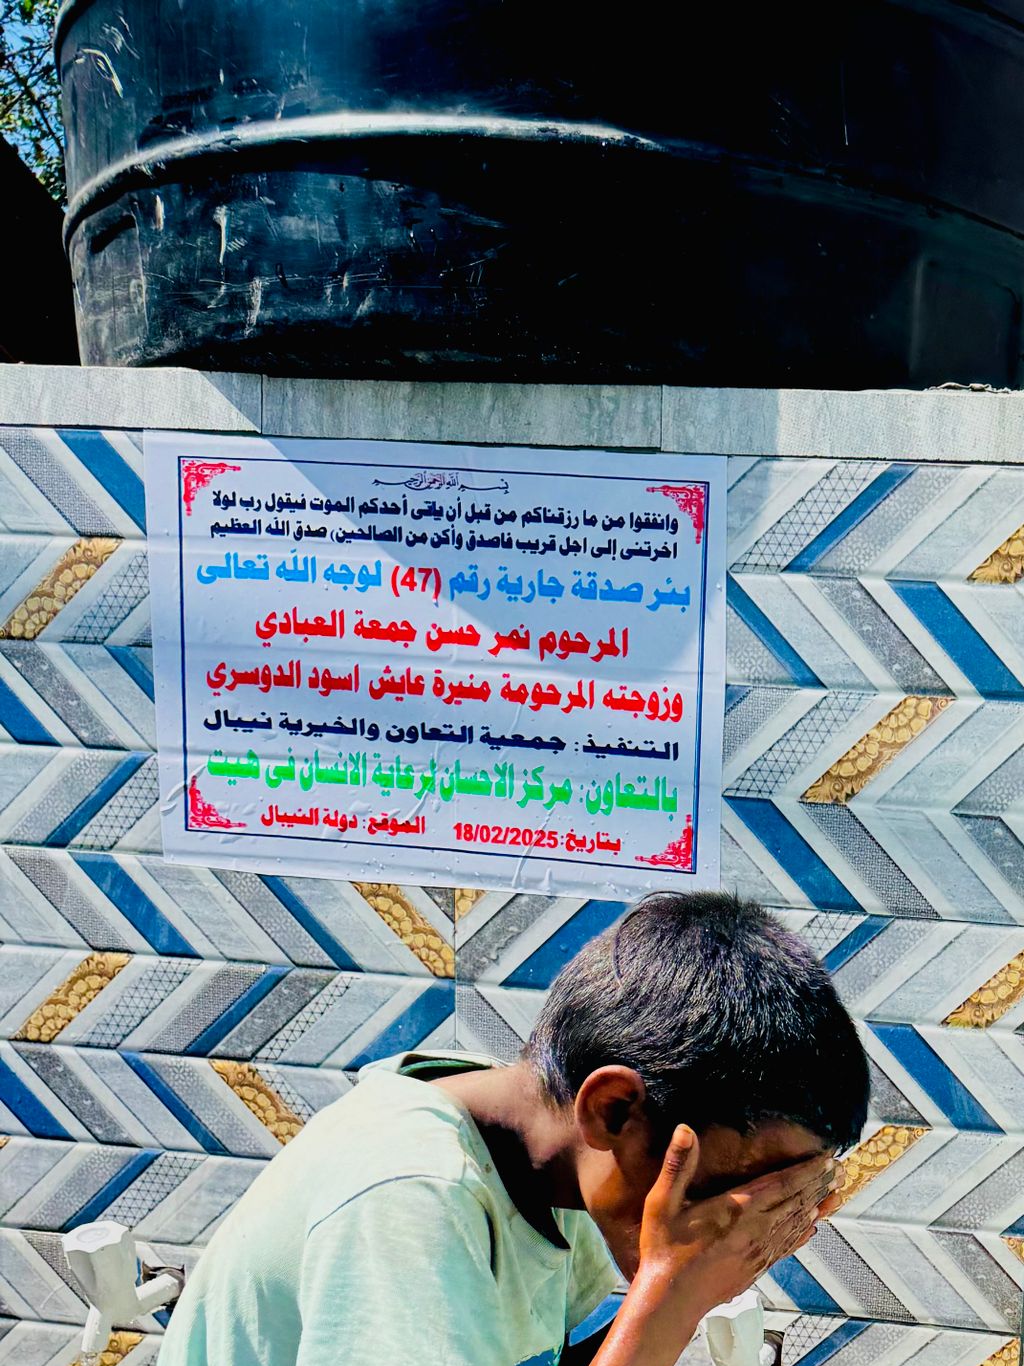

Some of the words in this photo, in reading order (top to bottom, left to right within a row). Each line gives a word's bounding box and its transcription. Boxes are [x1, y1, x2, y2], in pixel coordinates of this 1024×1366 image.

[212, 490, 236, 510] لولا
[239, 496, 262, 512] رب
[265, 493, 307, 512] فيقول
[310, 496, 355, 515] الموت
[358, 494, 407, 518] أحدكم
[446, 496, 462, 522] أن
[465, 503, 491, 523] قبل
[210, 518, 262, 538] العظيم
[265, 517, 290, 536] الله
[293, 522, 327, 541] صدق
[494, 509, 517, 525] من
[521, 507, 579, 529] رزقناكم
[583, 510, 598, 527] ما
[601, 515, 626, 531] من
[630, 511, 679, 534] وانفقوا
[405, 531, 428, 546] من
[430, 523, 463, 549] وأكن
[466, 529, 513, 551] فاصدق
[515, 534, 556, 555] قريب
[558, 536, 587, 556] اجل
[590, 538, 617, 561] إلى
[197, 552, 270, 584] تعالى
[276, 549, 317, 583] الله
[323, 560, 382, 592] لوجه
[391, 565, 442, 602] (47)
[449, 564, 491, 601] رقم
[496, 566, 565, 604] جارية
[571, 570, 644, 603] صدقة
[645, 577, 691, 613] بئر
[255, 607, 345, 648] العبادي
[353, 609, 417, 648] جمعة
[425, 622, 481, 651] حسن
[488, 624, 531, 657] نمر
[538, 627, 628, 662] المرحوم
[206, 659, 302, 697] الدوسري
[308, 664, 360, 697] اسود
[369, 665, 425, 702] عايش
[432, 669, 491, 706] منيرة
[500, 673, 595, 713] المرحومة
[602, 685, 683, 723] وزوجته
[203, 709, 273, 733] نيبال
[278, 712, 380, 741] والخيرية
[385, 724, 474, 744] التعاون
[479, 726, 567, 755] جمعية
[207, 749, 261, 786] هيت
[265, 747, 296, 789] فى
[300, 749, 367, 791] الانسان
[372, 751, 437, 800] لرعاية
[439, 759, 515, 802] الاحسان
[516, 765, 573, 810] مركز
[260, 804, 320, 829] النيبال
[322, 809, 358, 832] دولة
